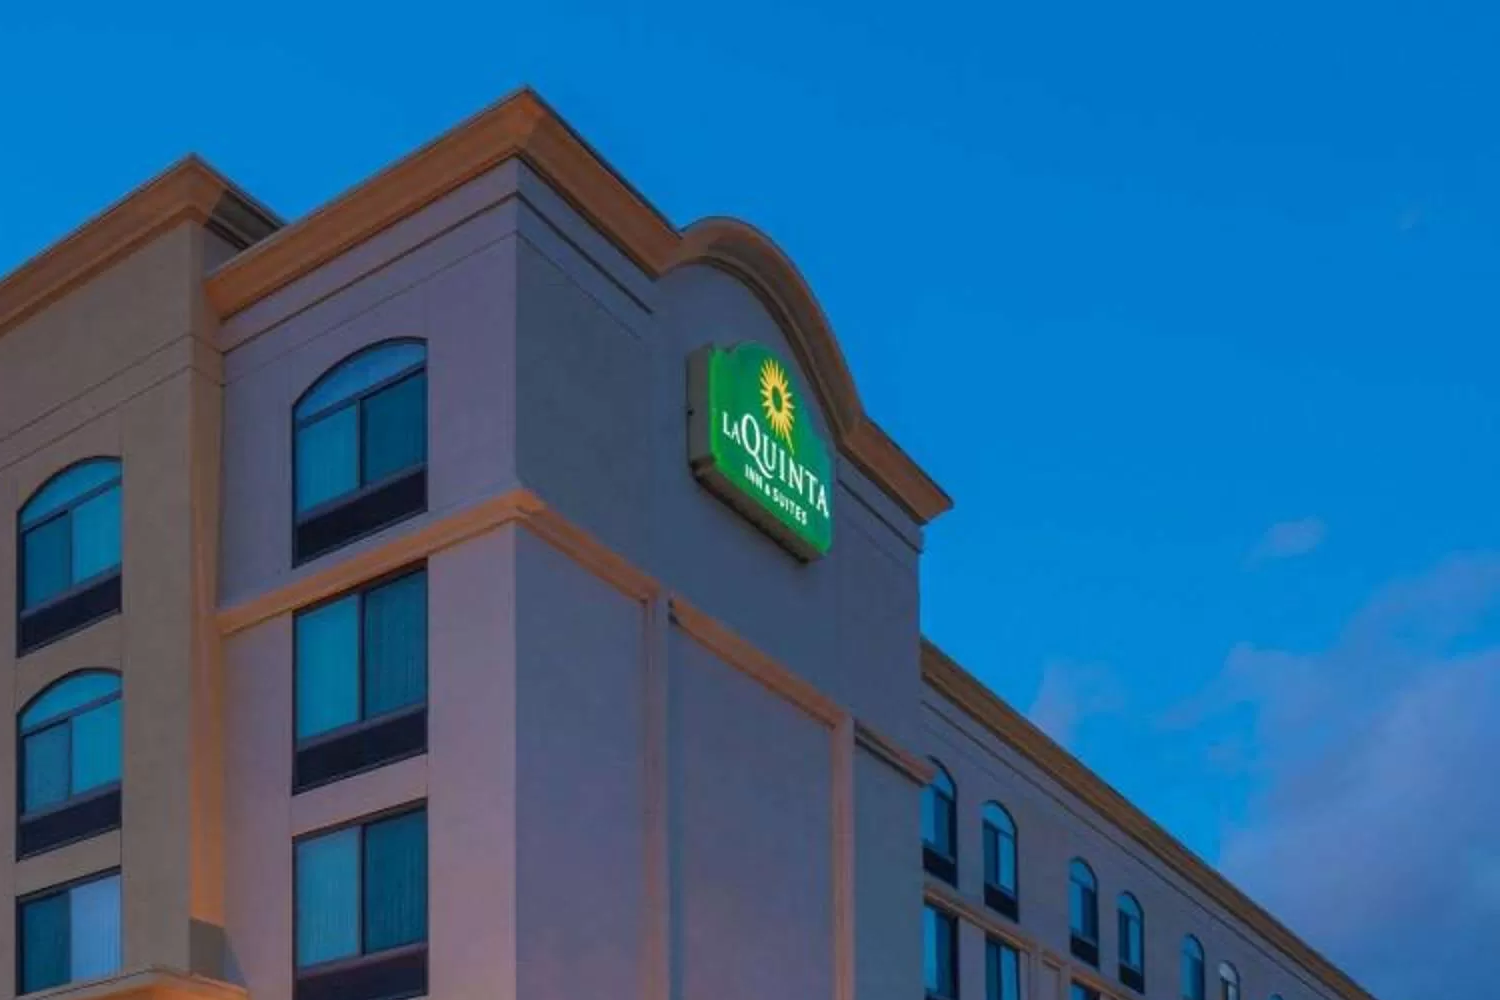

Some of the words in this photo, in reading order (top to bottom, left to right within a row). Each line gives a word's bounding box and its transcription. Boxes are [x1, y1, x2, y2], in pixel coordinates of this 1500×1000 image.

[722, 411, 741, 445] LA
[741, 413, 830, 518] QUINTA
[744, 463, 763, 489] INN
[764, 483, 771, 496] &
[772, 487, 808, 526] SUITES
